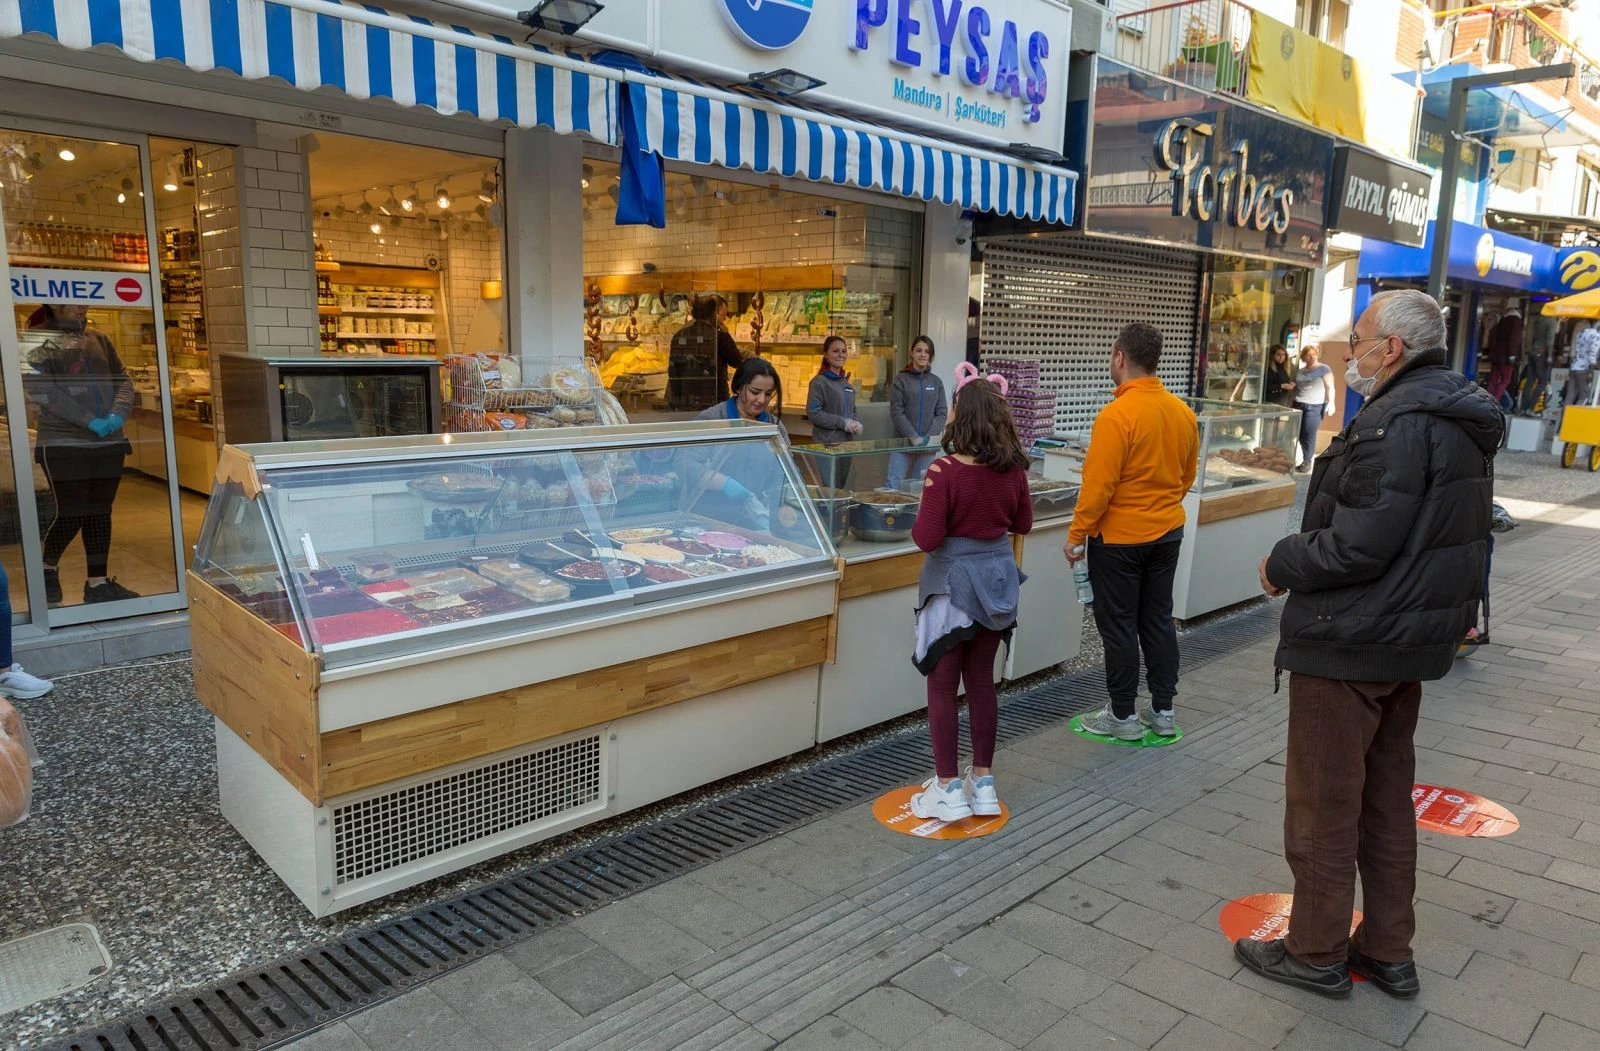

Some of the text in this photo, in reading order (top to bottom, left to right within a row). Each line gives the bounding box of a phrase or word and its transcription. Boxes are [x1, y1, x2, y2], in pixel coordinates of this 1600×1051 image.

[850, 0, 1050, 123] PEYSAŞ
[894, 77, 1007, 129] Mandıra Şarküteri
[1153, 117, 1295, 234] Forbes
[1344, 175, 1429, 237] HAYAL GÜMÜŞ
[10, 274, 106, 300] RİLMEZ
[886, 809, 914, 825] MESA
[1248, 914, 1286, 941] AĞLIĞIN
